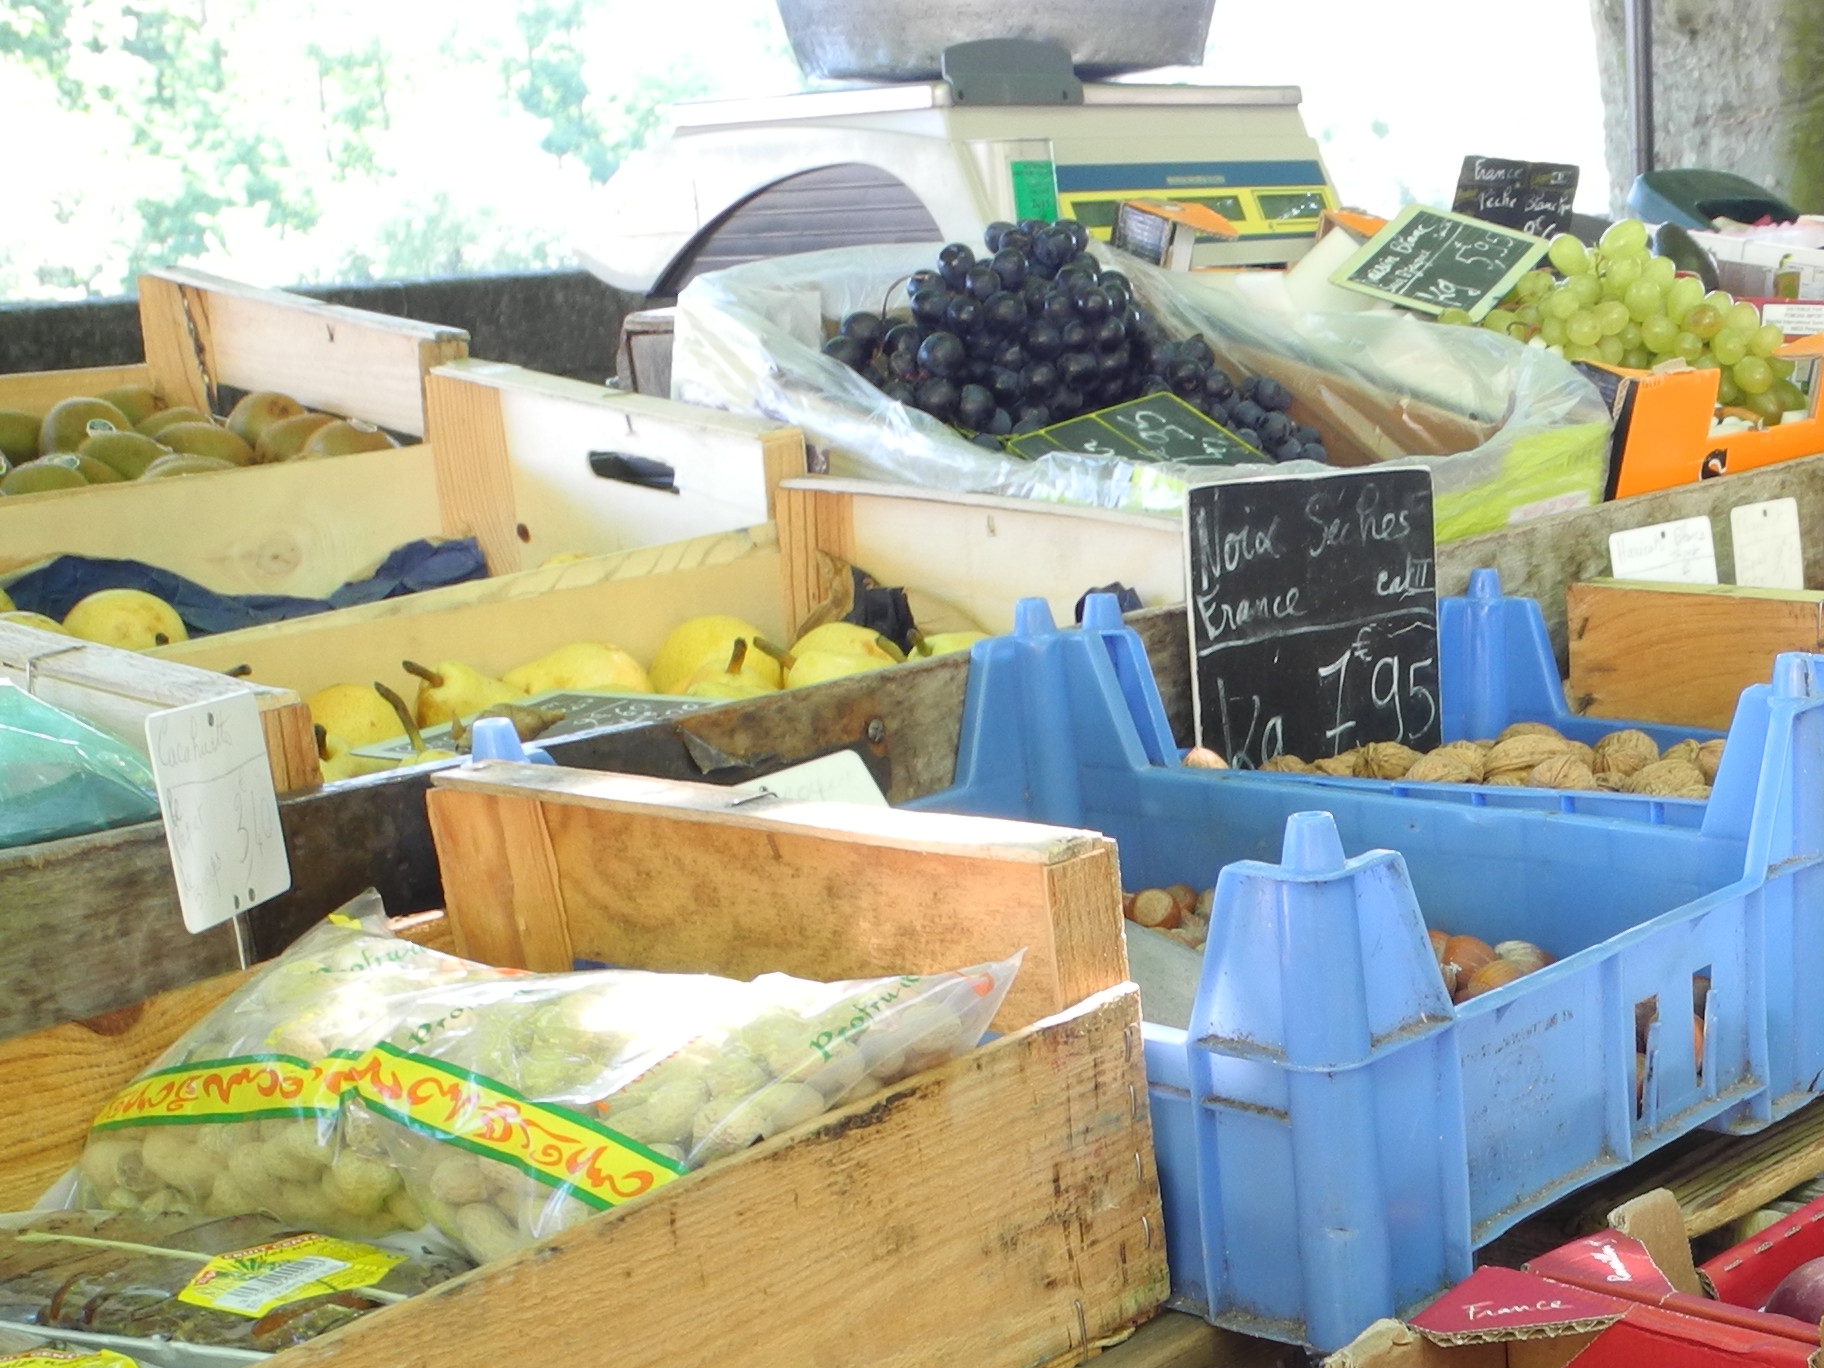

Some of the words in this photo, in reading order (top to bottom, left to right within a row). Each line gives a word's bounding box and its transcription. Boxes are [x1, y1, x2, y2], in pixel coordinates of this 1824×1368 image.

[1196, 489, 1281, 590] Noix
[1196, 583, 1307, 641] France
[1460, 1300, 1575, 1320] France
